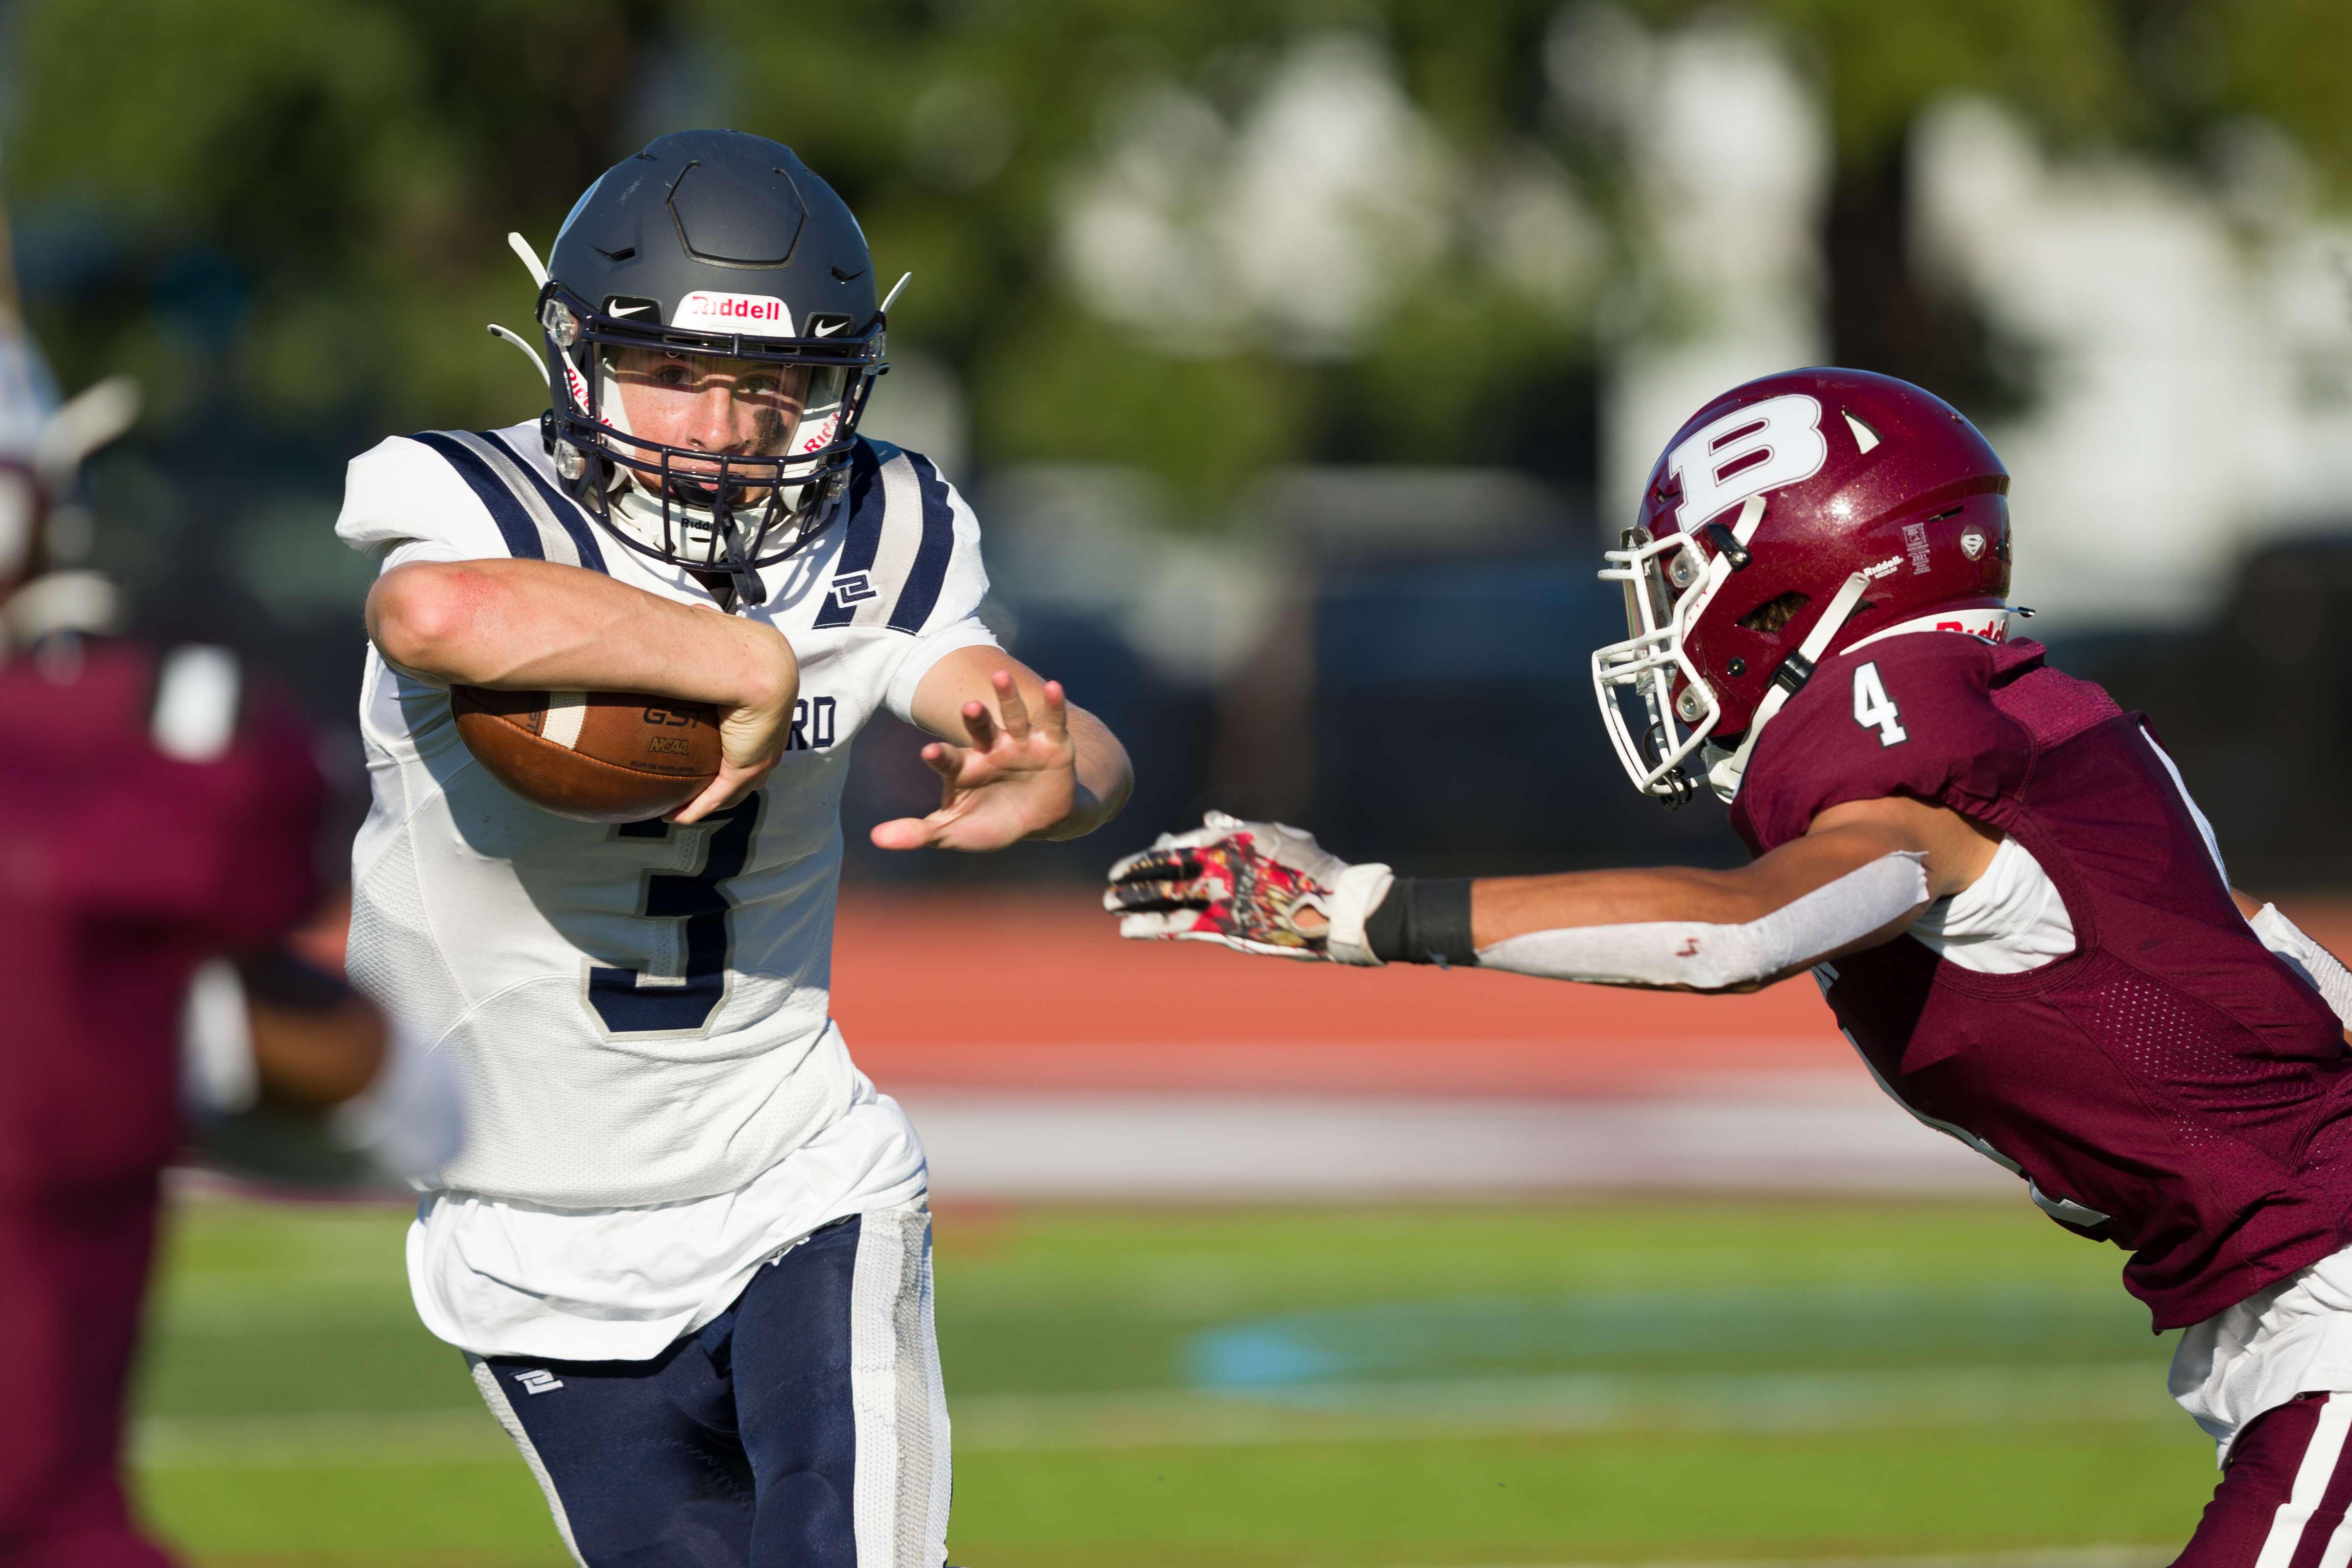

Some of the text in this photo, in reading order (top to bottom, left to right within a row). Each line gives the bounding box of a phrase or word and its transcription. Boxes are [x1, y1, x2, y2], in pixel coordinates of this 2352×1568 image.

[692, 296, 780, 320] Riddell
[1668, 394, 1828, 536] B
[1863, 555, 1901, 577] Riddell
[1912, 553, 1927, 562] 2021
[1875, 566, 1898, 579] MEDIUM
[643, 704, 707, 729] GST
[1854, 661, 1909, 748] 4
[647, 736, 689, 756] NCAA
[582, 787, 767, 1041] 3
